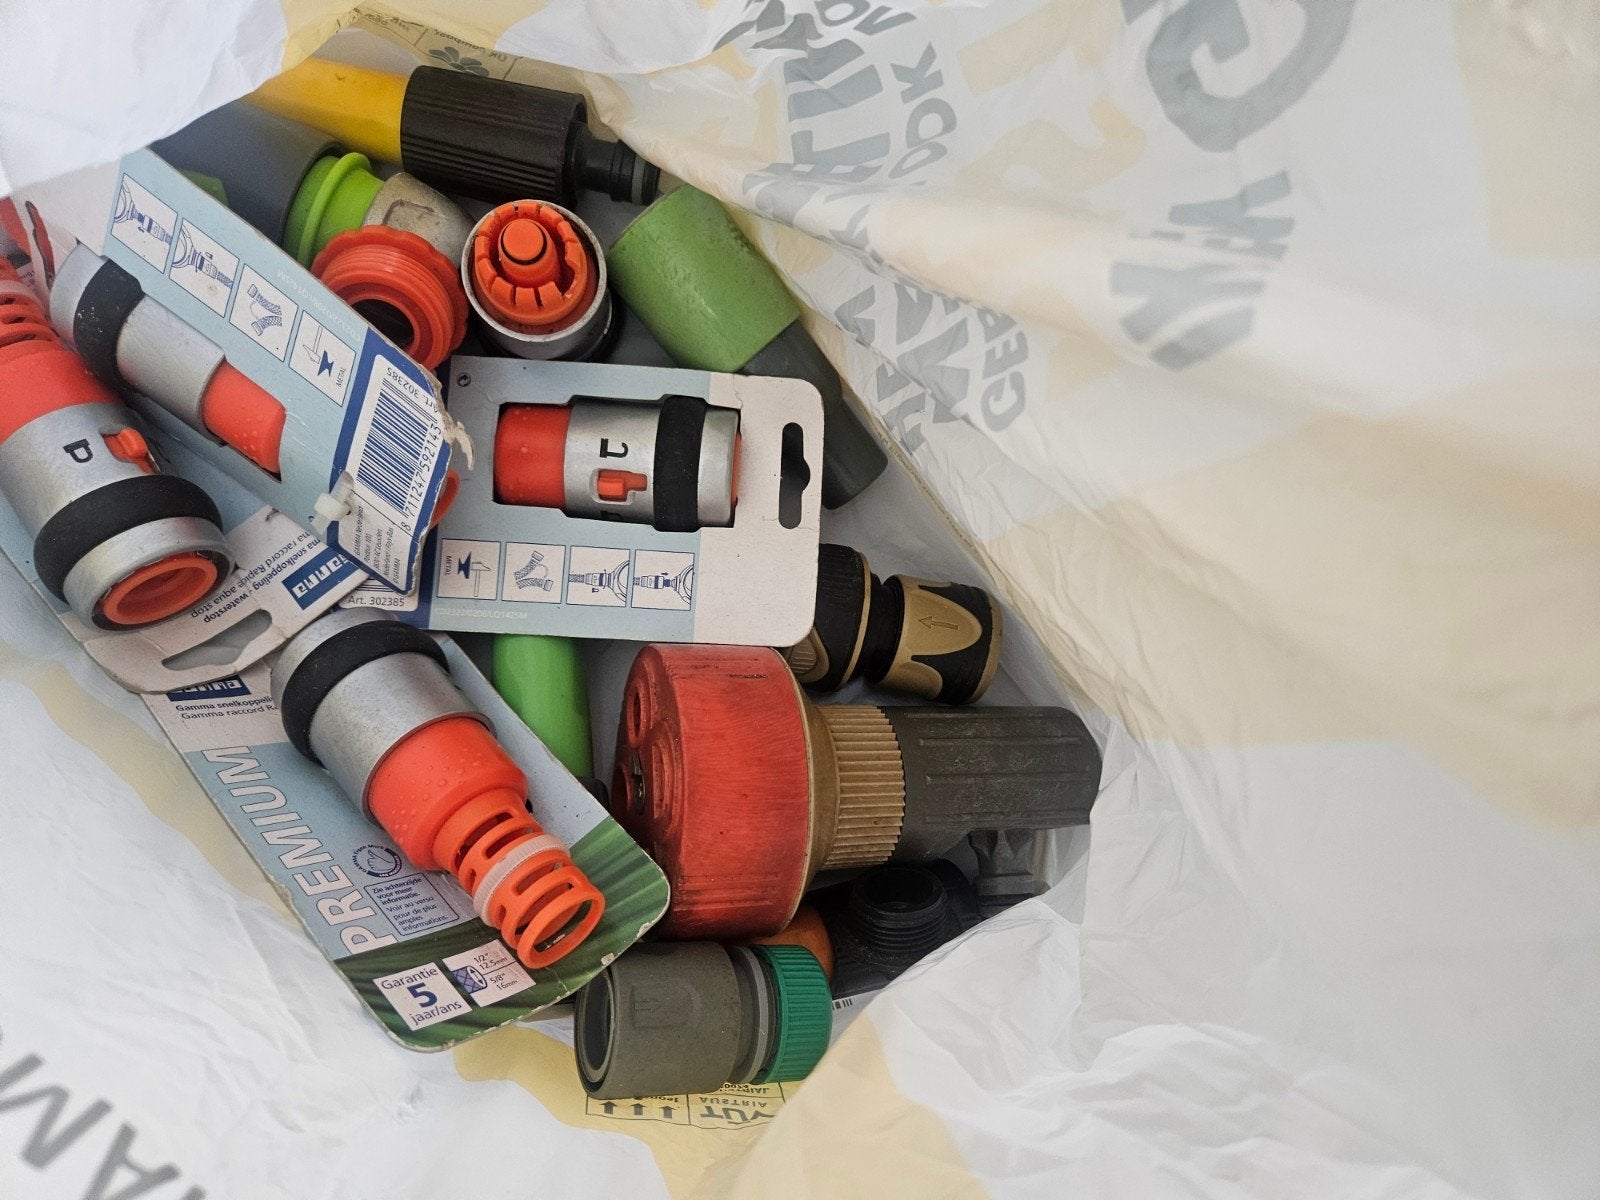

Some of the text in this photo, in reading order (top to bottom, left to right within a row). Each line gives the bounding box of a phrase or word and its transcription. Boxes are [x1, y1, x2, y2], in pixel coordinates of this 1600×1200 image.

[336, 366, 347, 388] METAL
[386, 366, 424, 400] 302385
[400, 422, 442, 532] 8 711247 592143
[265, 540, 297, 566] raccord
[238, 564, 267, 588] Rapide
[252, 546, 308, 591] snelkoppeling
[444, 555, 452, 576] METAL
[213, 586, 237, 605] aqua
[347, 595, 405, 607] Art. 302385
[190, 601, 213, 618] stop
[203, 592, 250, 623] waterstop
[175, 695, 273, 712] Gamma snelkoppeli
[181, 711, 225, 720] Gamma
[226, 706, 264, 716] raccord
[200, 745, 398, 955] PREMIUM
[376, 886, 413, 900] voor meer
[385, 877, 422, 890] achterzijde
[386, 904, 403, 912] Voir
[414, 896, 434, 905] verso
[393, 911, 411, 921] pour
[422, 904, 437, 913] plus
[398, 915, 424, 926] amples
[381, 967, 439, 989] Garantie
[496, 980, 518, 991] 16mm
[406, 982, 438, 1008] 5
[409, 1000, 462, 1025] jaar/ans
